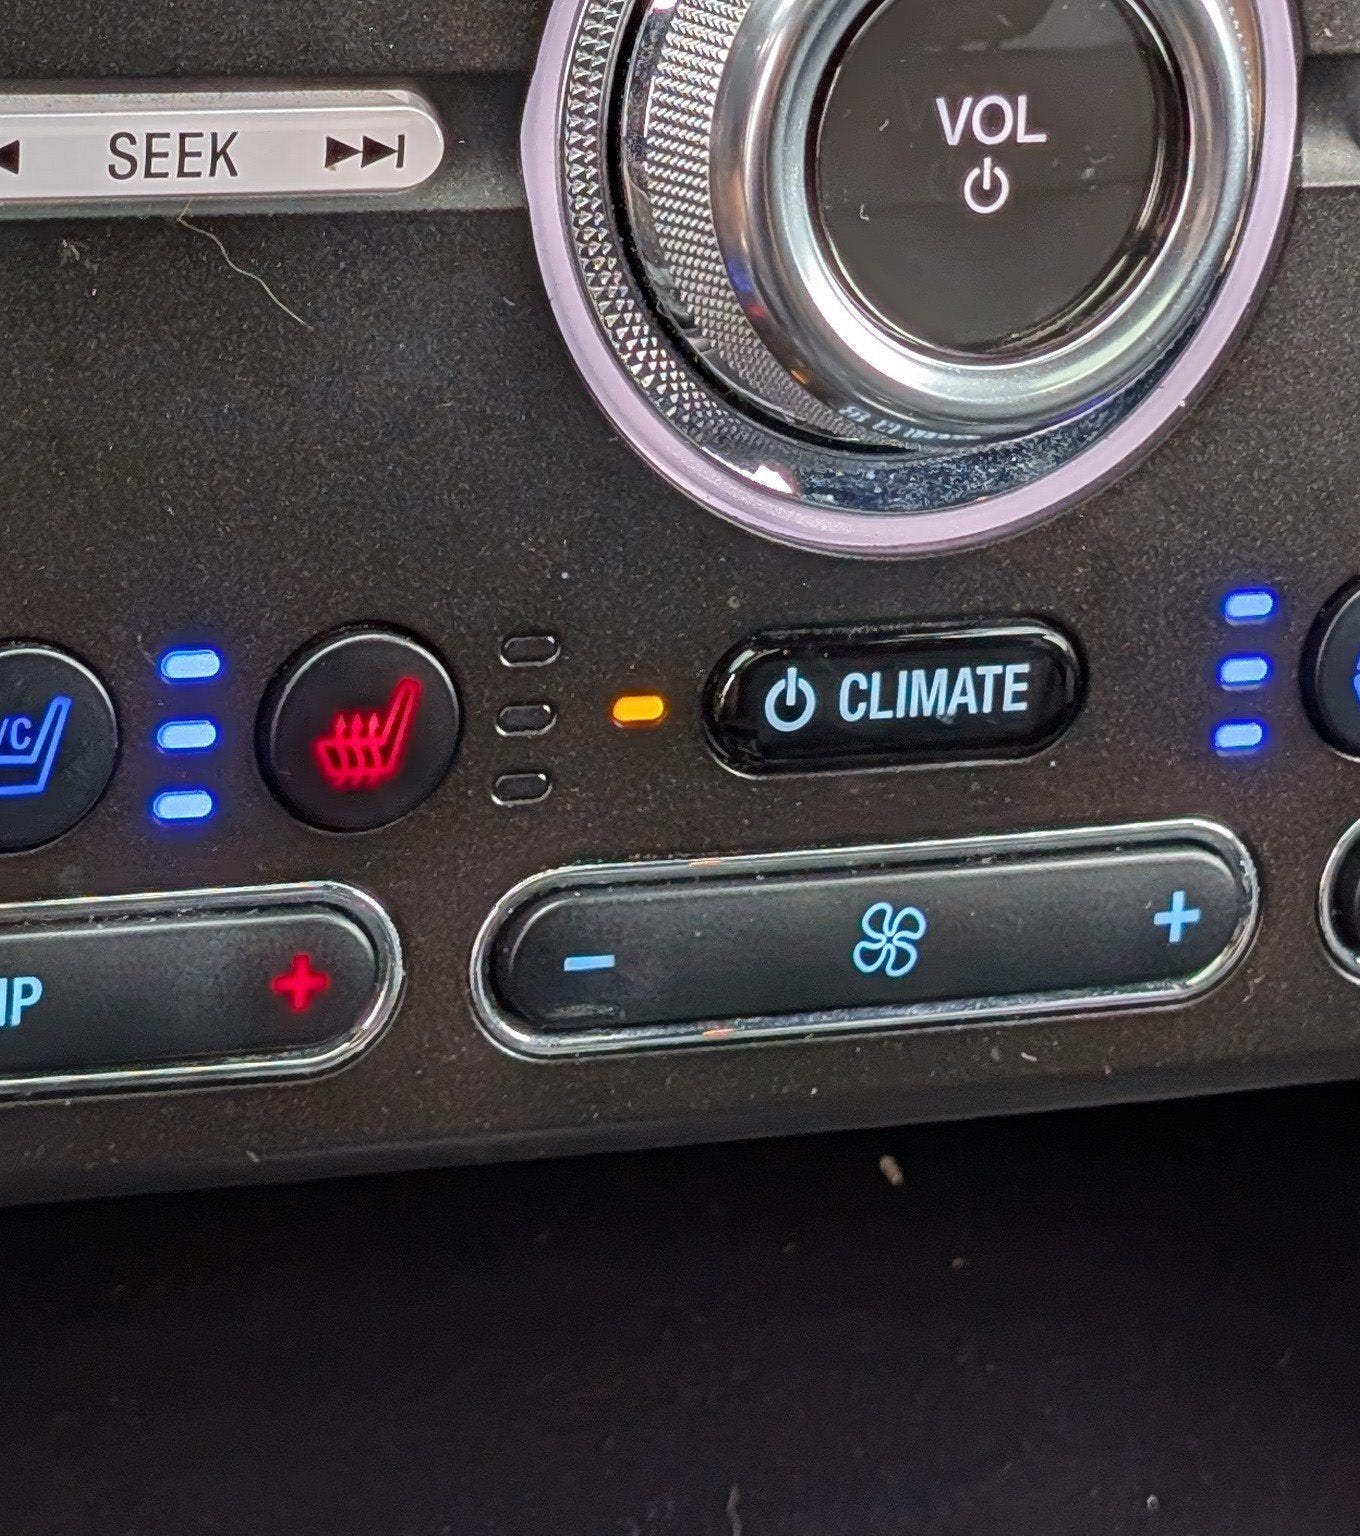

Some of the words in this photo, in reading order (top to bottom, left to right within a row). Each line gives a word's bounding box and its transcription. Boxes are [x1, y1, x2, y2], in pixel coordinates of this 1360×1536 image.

[936, 95, 1047, 145] VOL
[108, 131, 239, 180] SEEK
[840, 663, 1031, 722] CLIMATE
